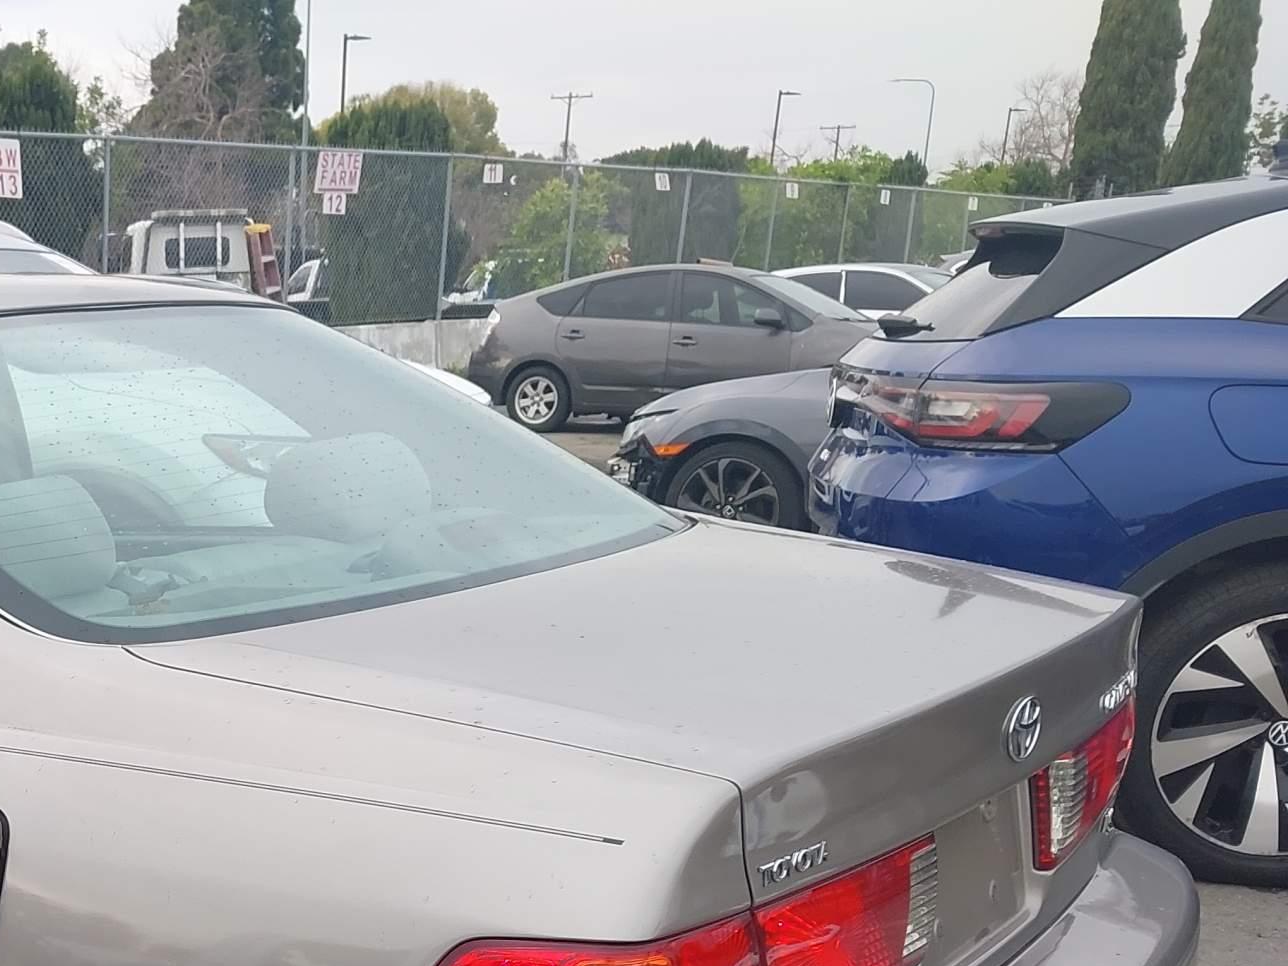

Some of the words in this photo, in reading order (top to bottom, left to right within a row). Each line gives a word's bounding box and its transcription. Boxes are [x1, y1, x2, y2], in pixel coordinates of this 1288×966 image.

[321, 152, 361, 170] STATE
[319, 170, 358, 186] FARM
[488, 164, 497, 183] 11
[328, 194, 343, 213] 12
